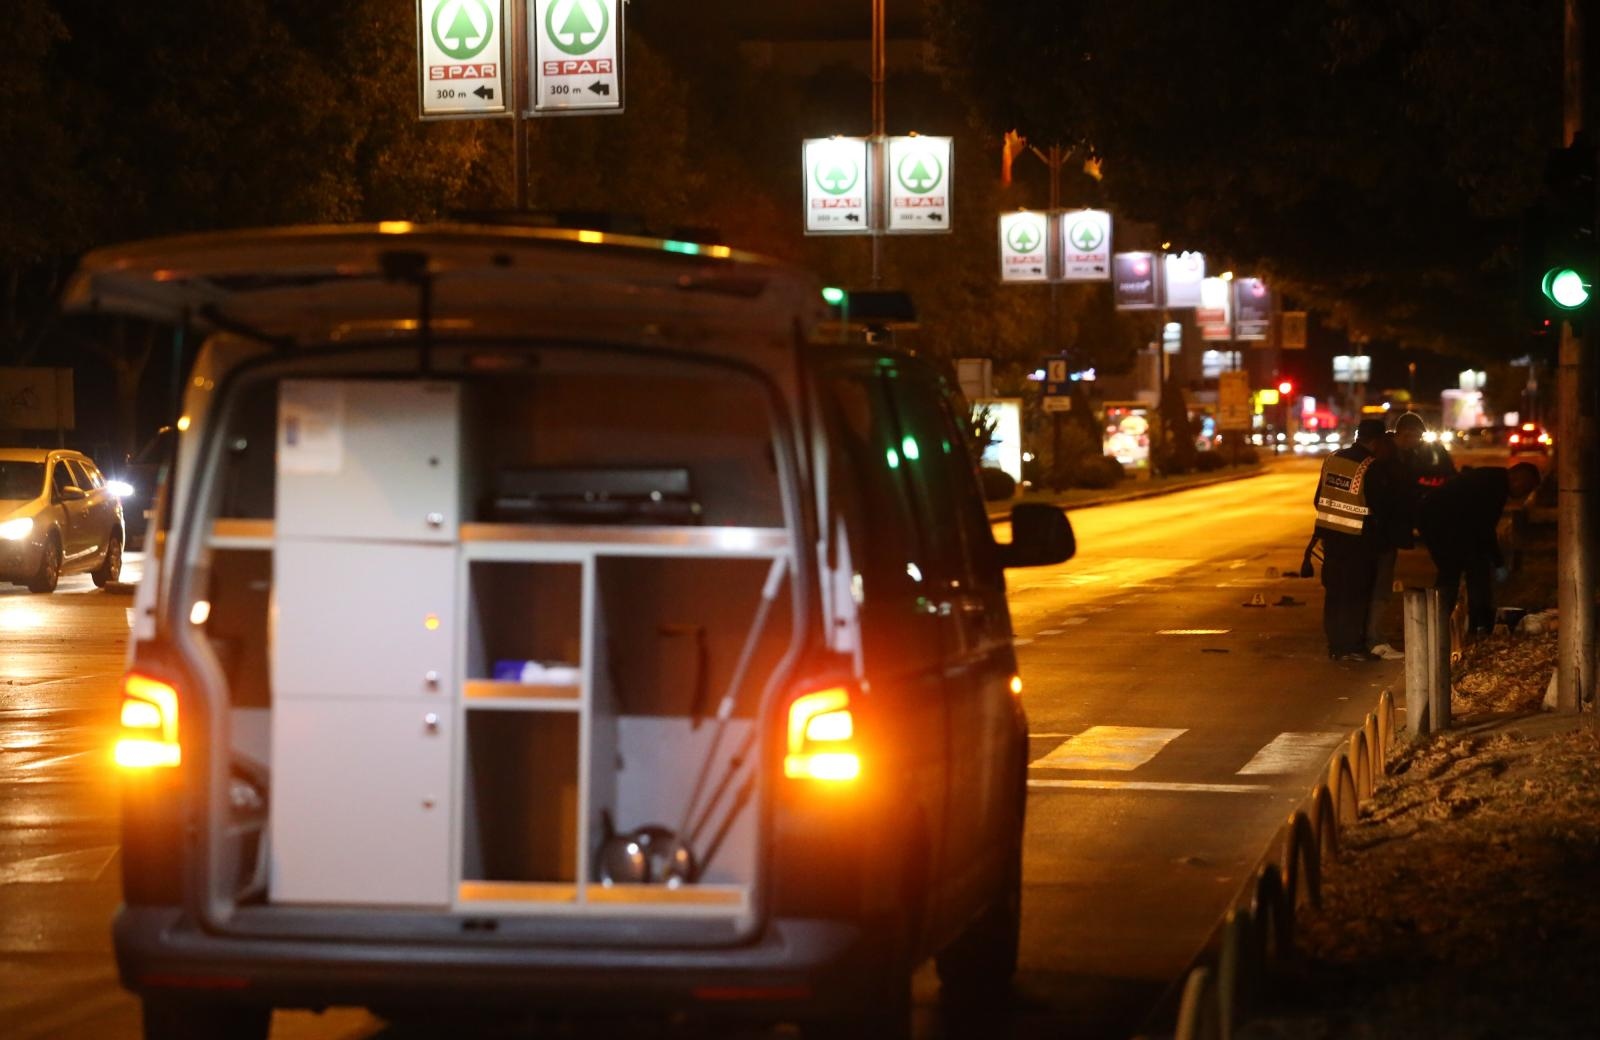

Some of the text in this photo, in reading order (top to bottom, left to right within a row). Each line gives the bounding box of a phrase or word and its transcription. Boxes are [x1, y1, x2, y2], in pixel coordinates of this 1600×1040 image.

[430, 65, 495, 79] SPAR
[545, 60, 611, 75] SPAR
[436, 89, 455, 99] 300
[550, 85, 569, 95] 300
